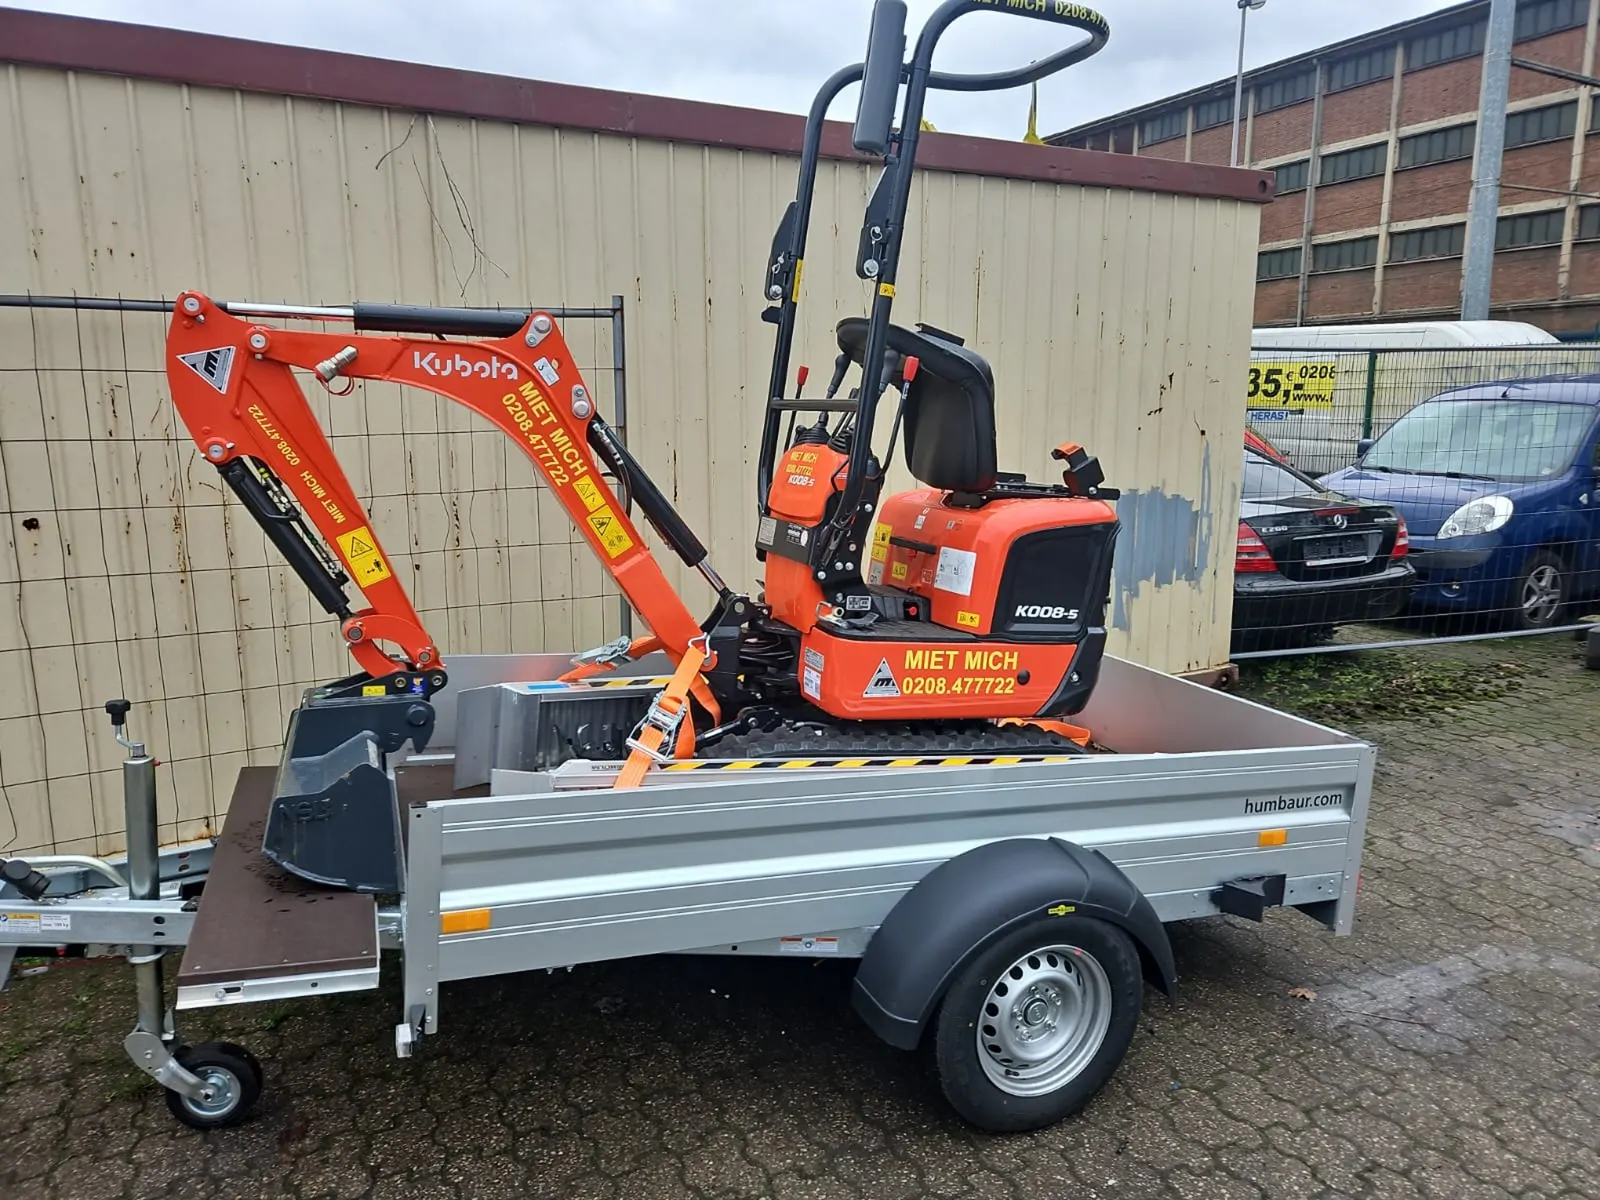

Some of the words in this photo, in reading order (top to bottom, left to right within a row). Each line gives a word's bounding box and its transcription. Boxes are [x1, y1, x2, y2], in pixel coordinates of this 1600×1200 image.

[413, 351, 518, 380] Kubota
[248, 404, 300, 466] 0208.477722
[502, 393, 570, 486] 0208.477722
[518, 381, 557, 425] MIET
[550, 428, 588, 476] MICH
[300, 470, 326, 499] MICH
[321, 499, 346, 524] MIET
[904, 650, 959, 670] MIET
[964, 652, 1019, 670] MICH
[902, 676, 1015, 694] 0208.477722
[1244, 793, 1342, 814] humbaur.com
